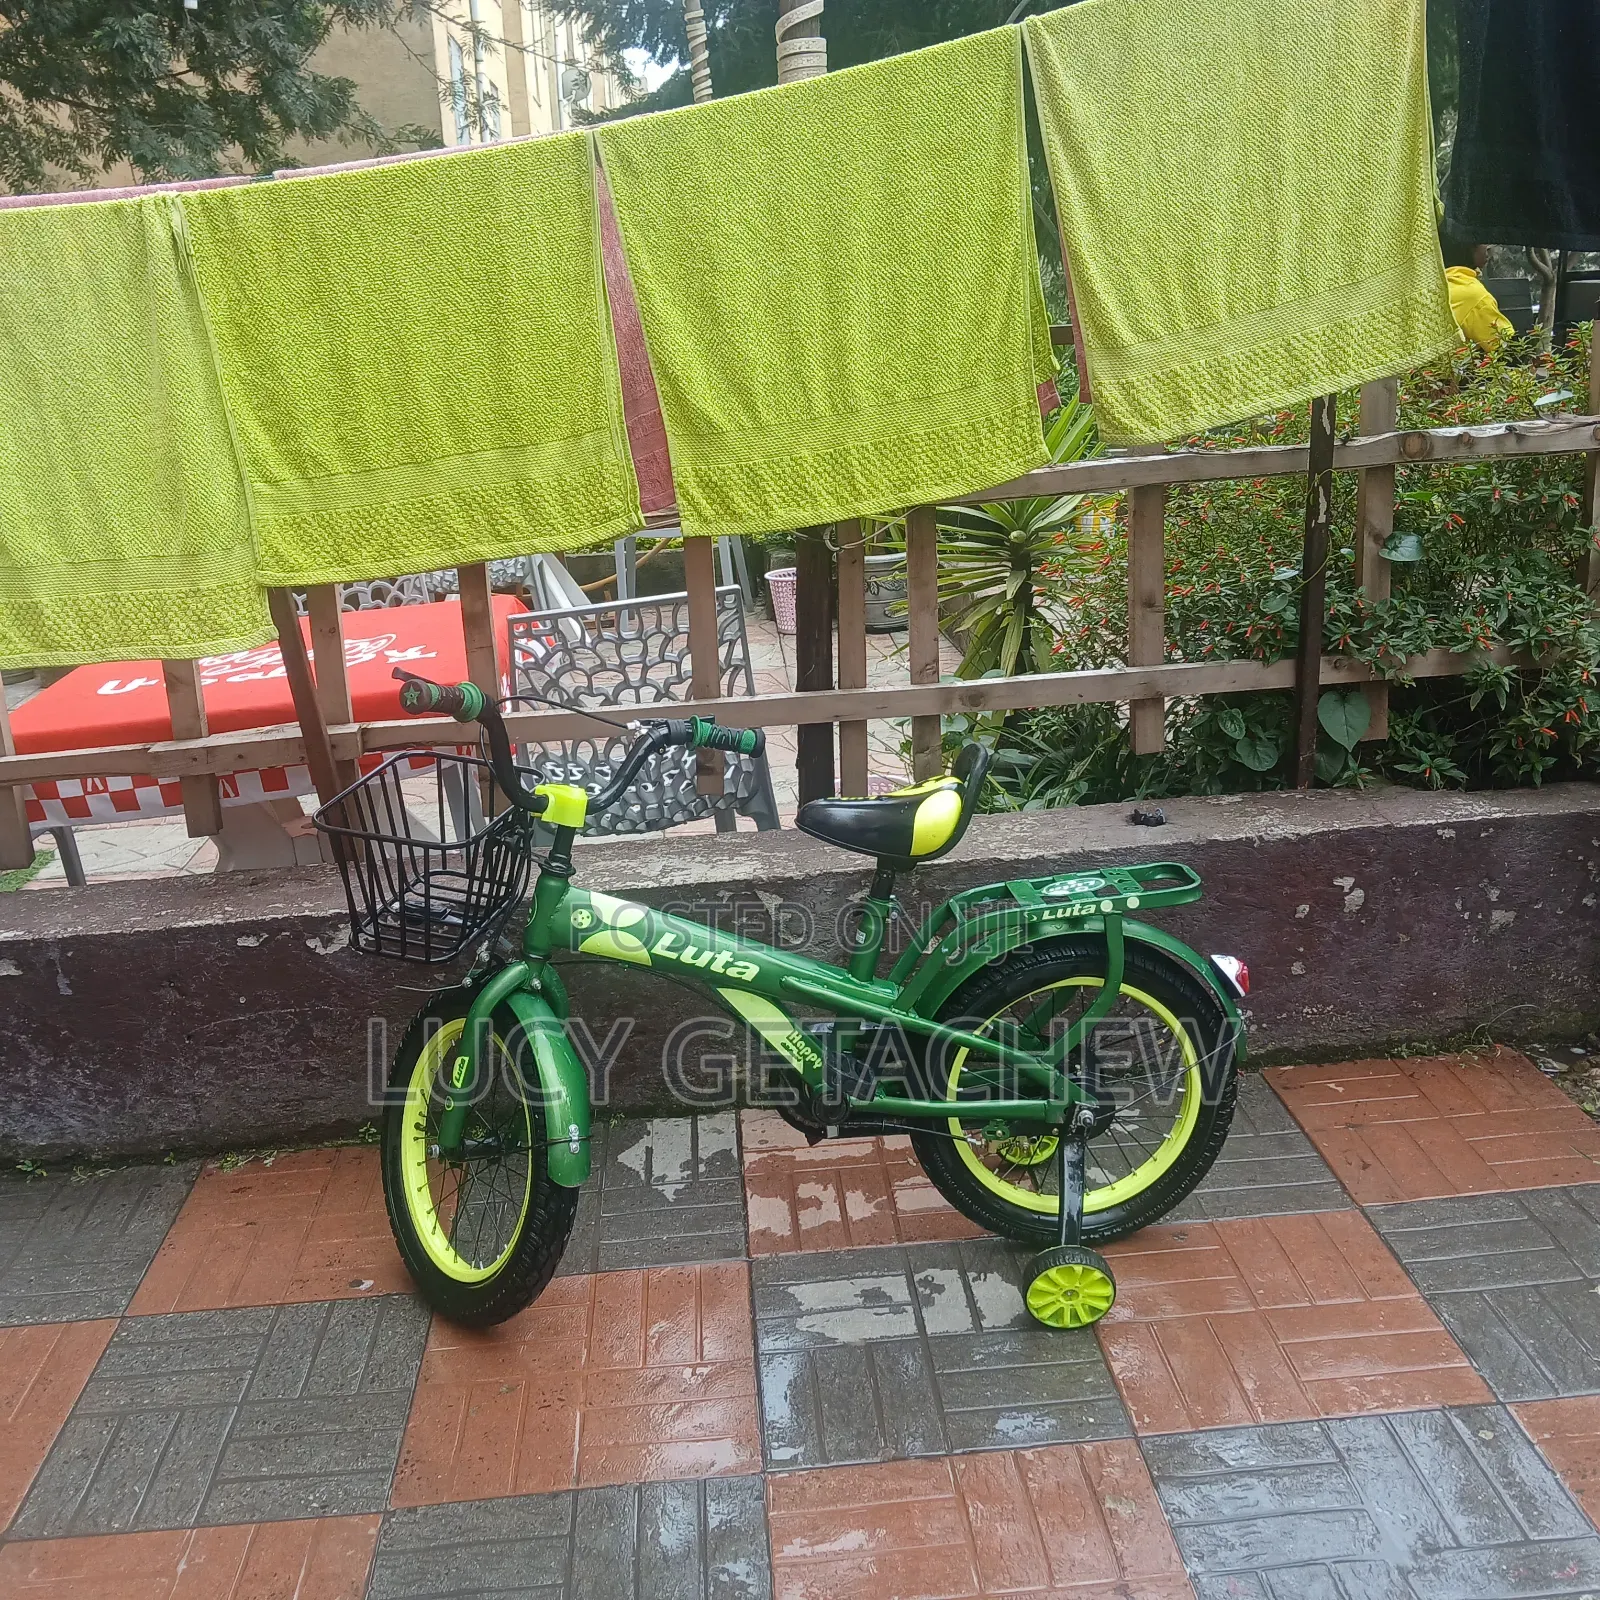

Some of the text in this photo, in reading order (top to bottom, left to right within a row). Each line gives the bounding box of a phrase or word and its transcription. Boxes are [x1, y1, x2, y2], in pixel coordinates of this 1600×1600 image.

[1041, 903, 1097, 920] Luta
[650, 932, 760, 982] Luta
[788, 1030, 823, 1069] Happy
